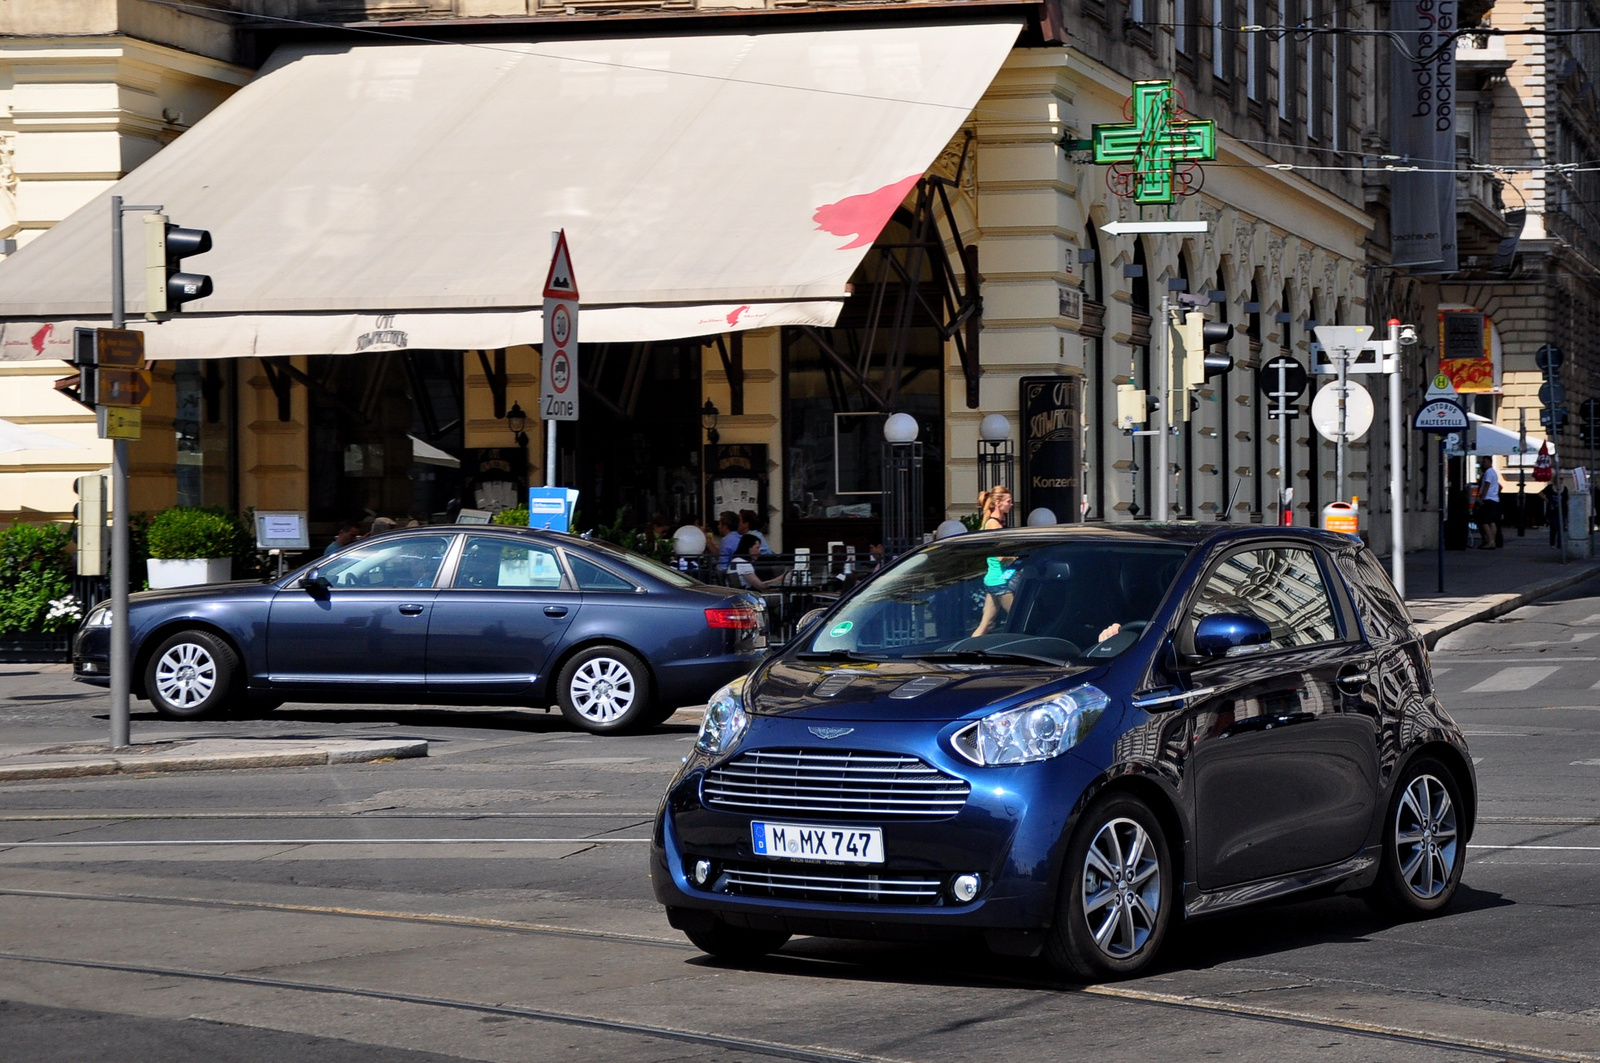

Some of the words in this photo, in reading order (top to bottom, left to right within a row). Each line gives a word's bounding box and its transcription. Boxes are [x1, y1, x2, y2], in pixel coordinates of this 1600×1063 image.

[555, 315, 566, 336] 30
[546, 394, 574, 416] Zone
[1426, 402, 1458, 414] AUTOBUS
[799, 829, 828, 855] MX
[831, 831, 872, 857] 747
